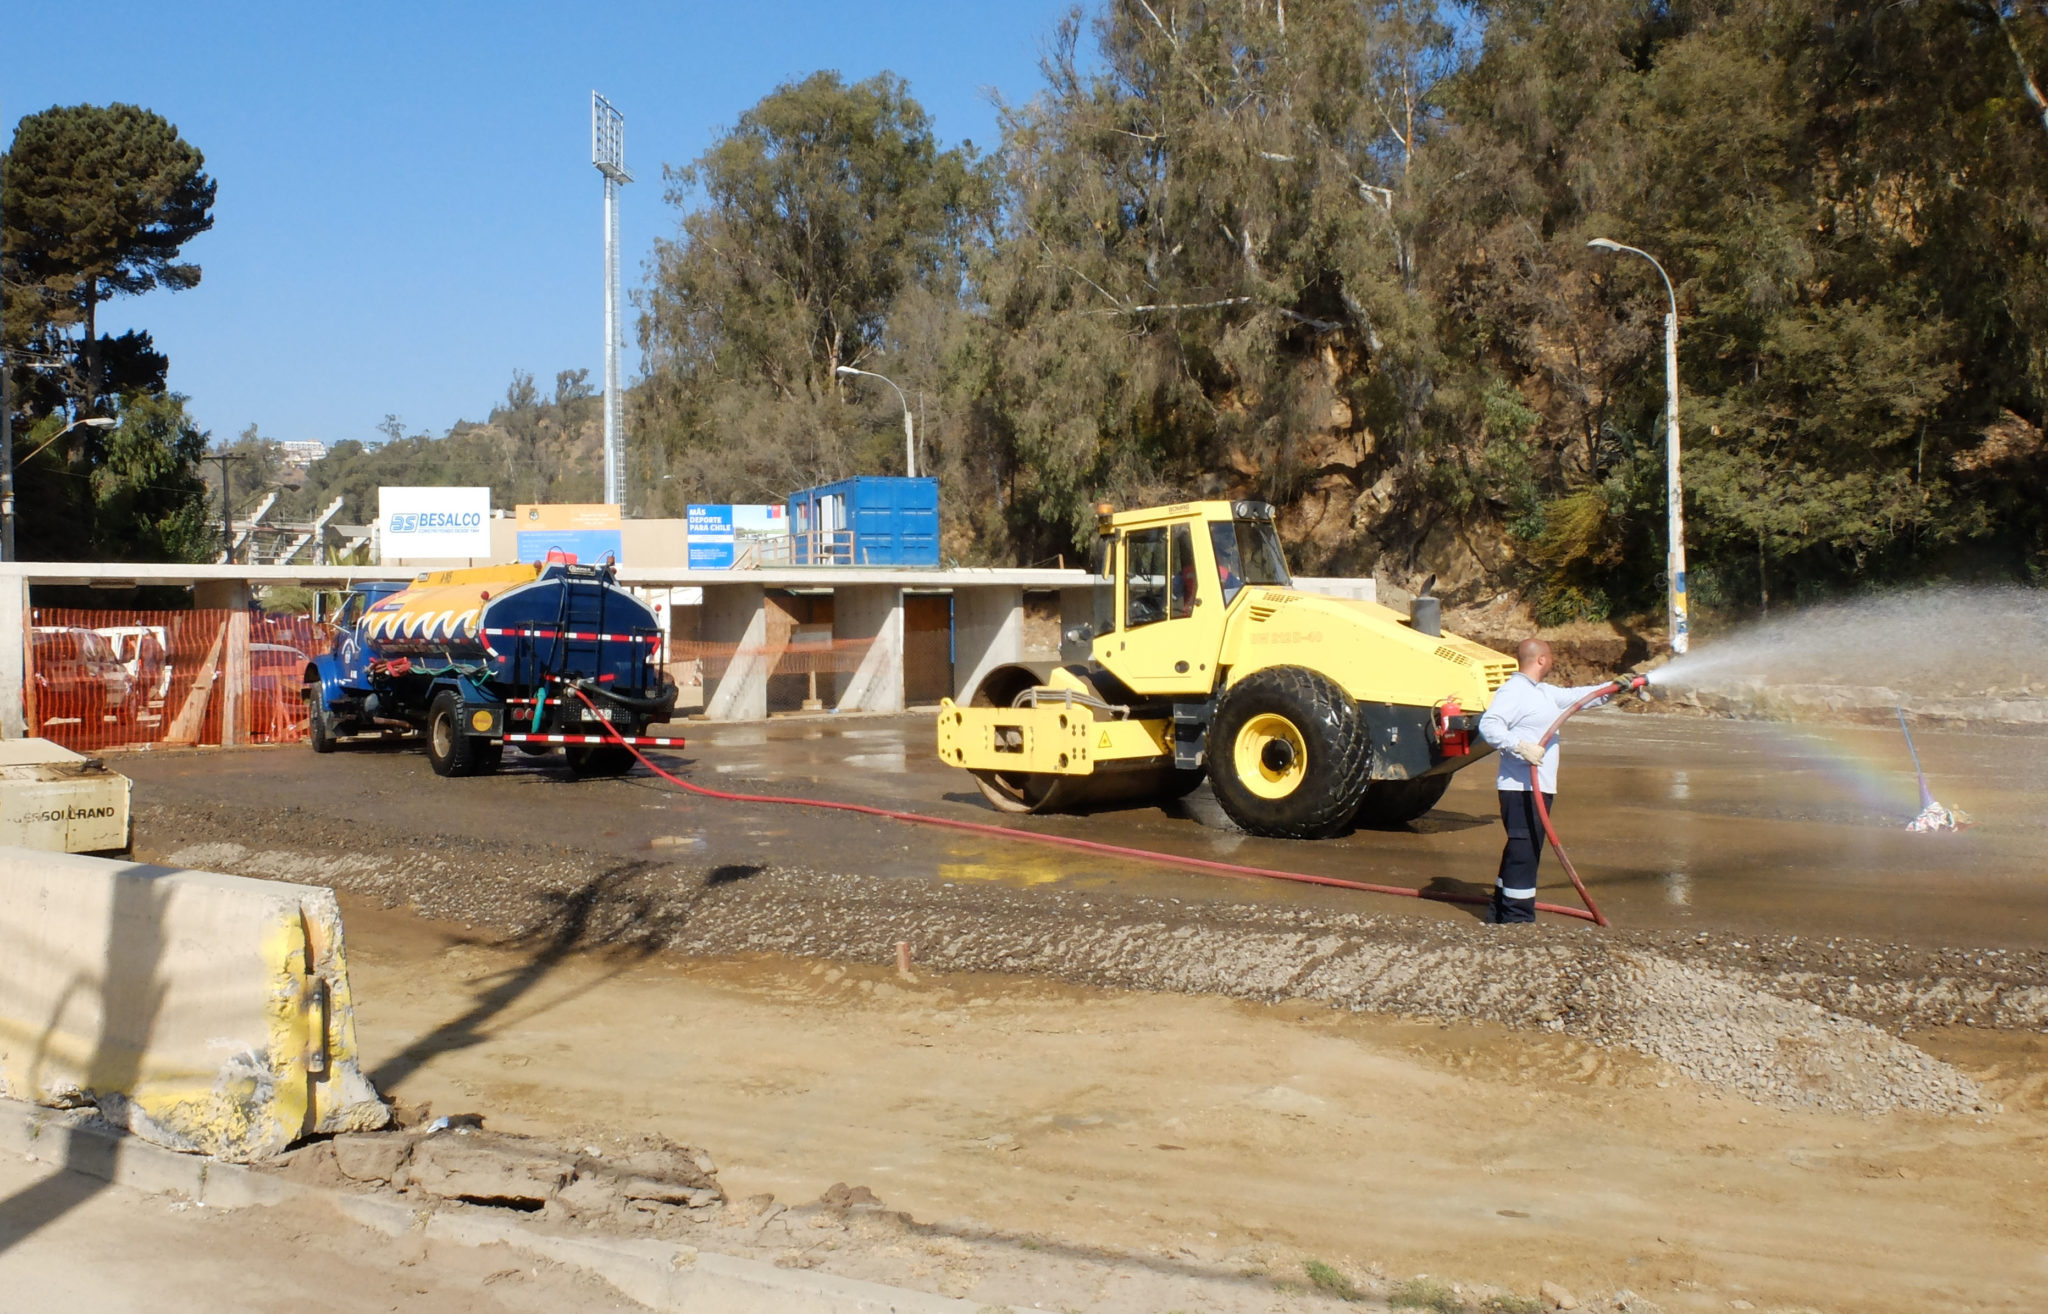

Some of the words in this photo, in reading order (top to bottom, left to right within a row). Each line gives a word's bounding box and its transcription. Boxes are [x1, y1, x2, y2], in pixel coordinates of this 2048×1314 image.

[689, 507, 706, 516] MÁS
[419, 512, 480, 527] BESALCO
[689, 516, 722, 524] DEPORTE
